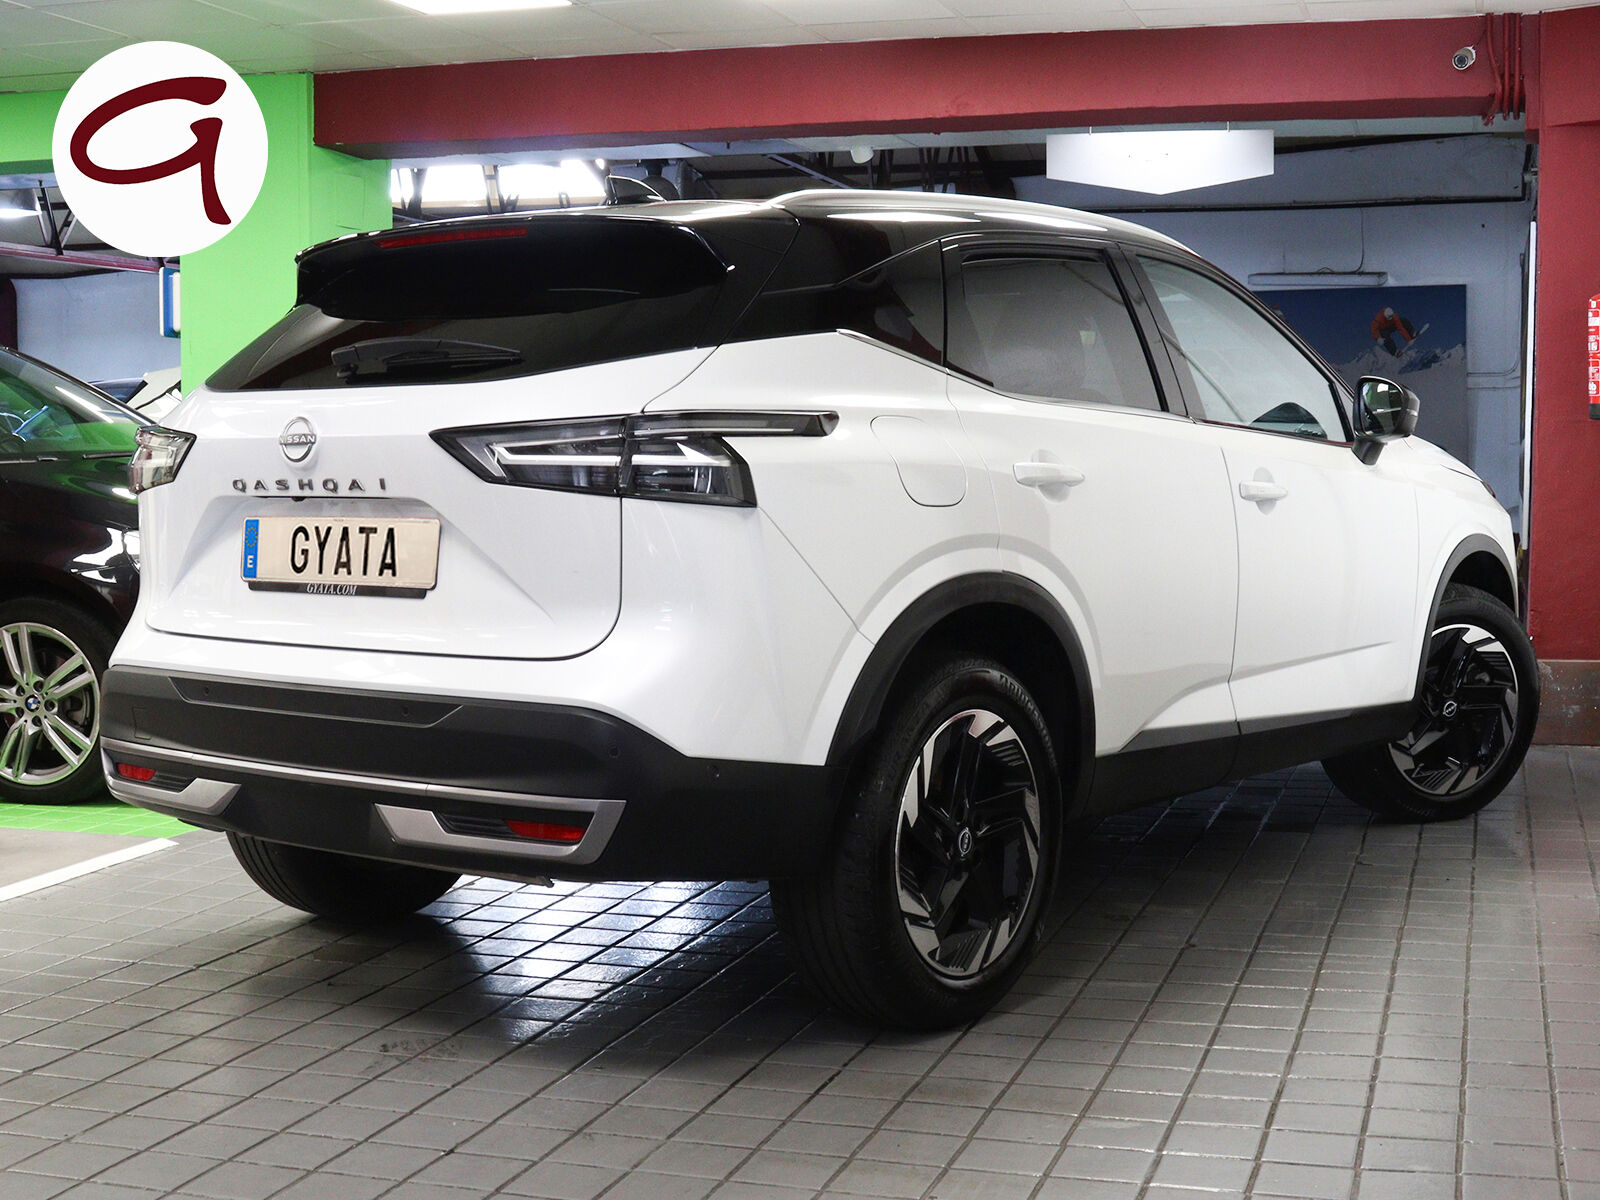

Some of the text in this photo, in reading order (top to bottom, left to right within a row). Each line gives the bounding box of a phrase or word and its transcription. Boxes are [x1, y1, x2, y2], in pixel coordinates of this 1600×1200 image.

[280, 434, 315, 443] NISSAN
[232, 479, 386, 493] QASHQAI
[290, 525, 397, 577] GYATA
[247, 555, 254, 569] E
[306, 583, 358, 596] GYATA.COM
